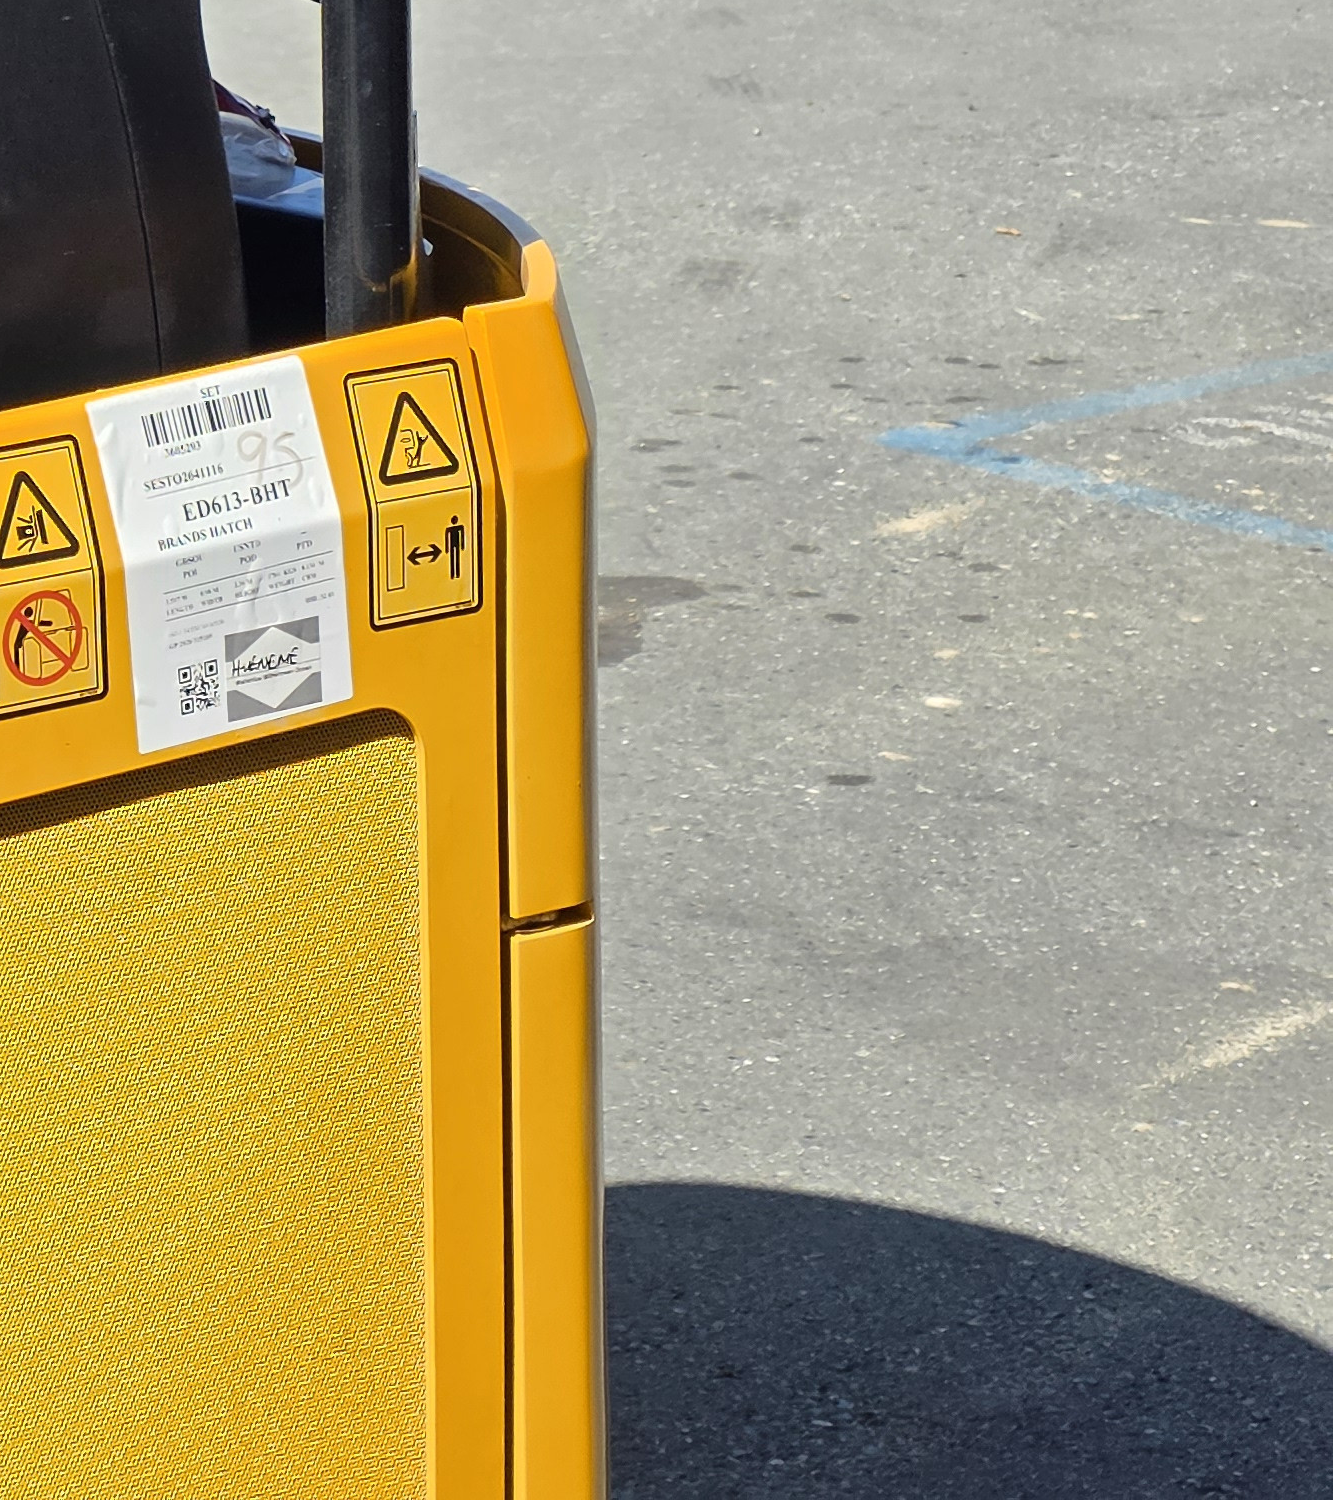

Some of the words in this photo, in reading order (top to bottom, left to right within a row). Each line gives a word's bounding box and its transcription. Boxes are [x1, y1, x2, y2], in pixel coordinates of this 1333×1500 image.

[200, 385, 221, 398] SET
[236, 430, 304, 490] 95
[182, 478, 292, 522] ED613-BHT
[158, 528, 207, 551] BRANDS
[209, 518, 253, 538] HATCH
